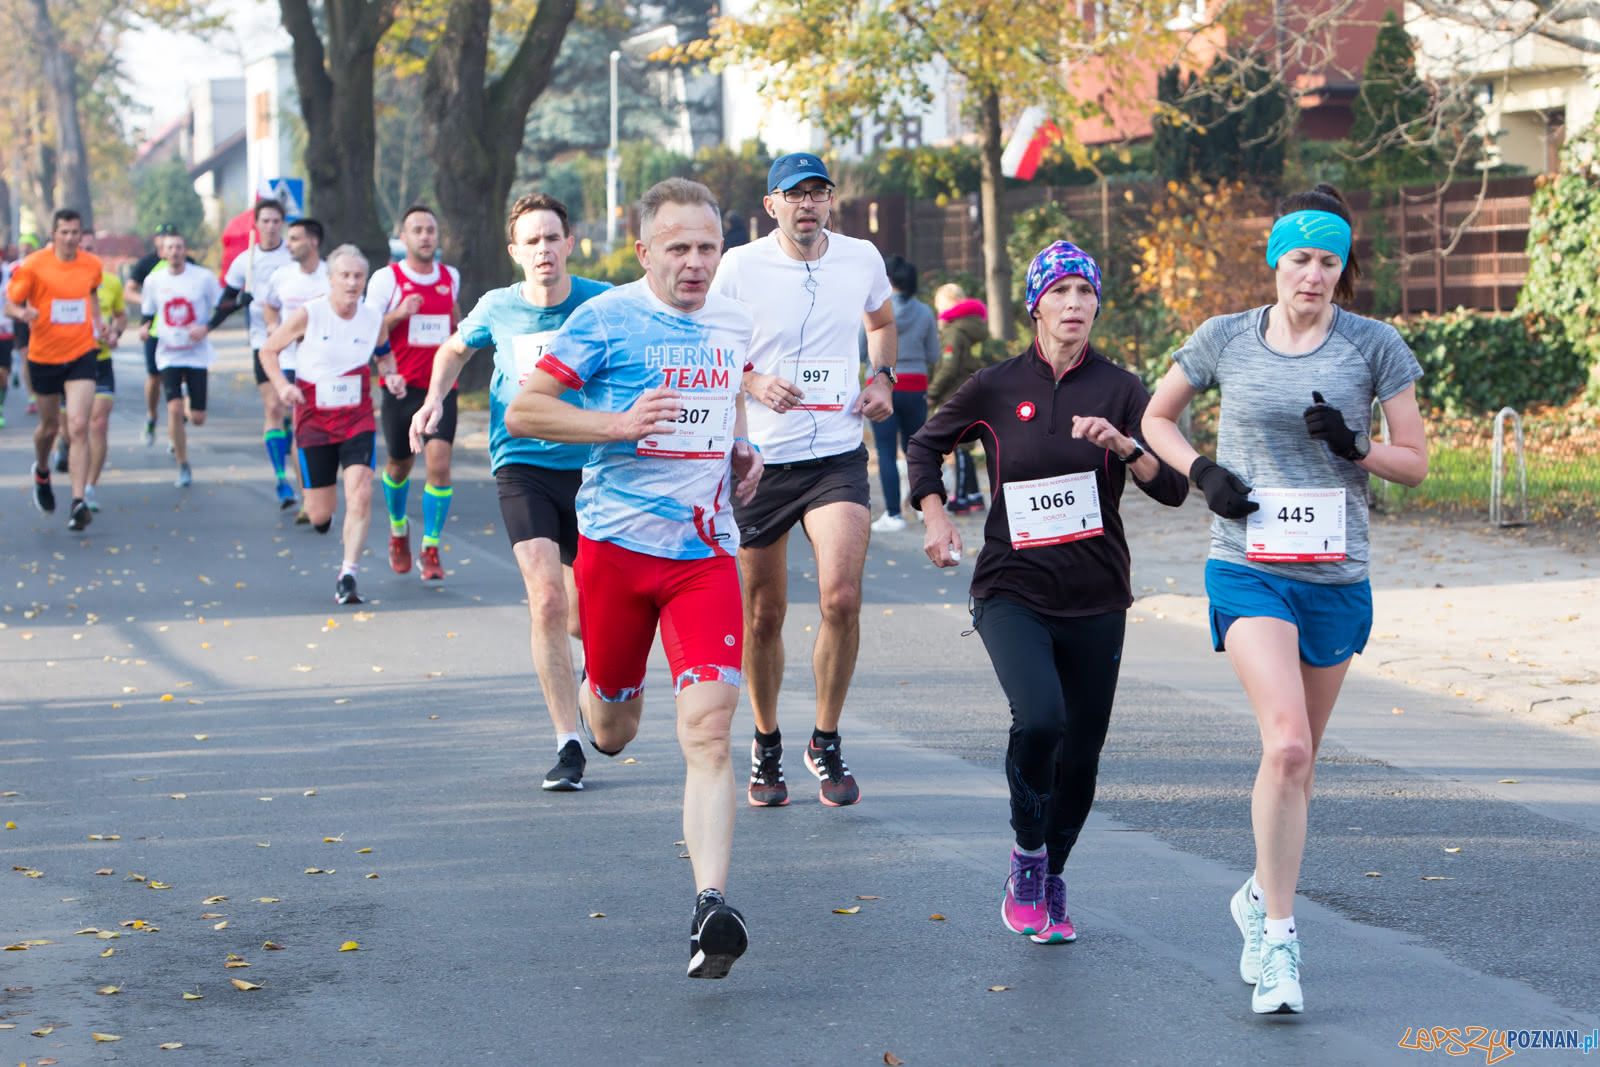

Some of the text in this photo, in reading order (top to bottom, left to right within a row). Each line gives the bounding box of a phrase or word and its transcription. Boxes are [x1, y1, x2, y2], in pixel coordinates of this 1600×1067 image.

[645, 346, 736, 368] HERNIK
[662, 368, 729, 389] TEAM
[802, 369, 830, 383] 997
[666, 408, 710, 424] 307
[1029, 490, 1075, 512] 1066
[1277, 506, 1315, 523] 445
